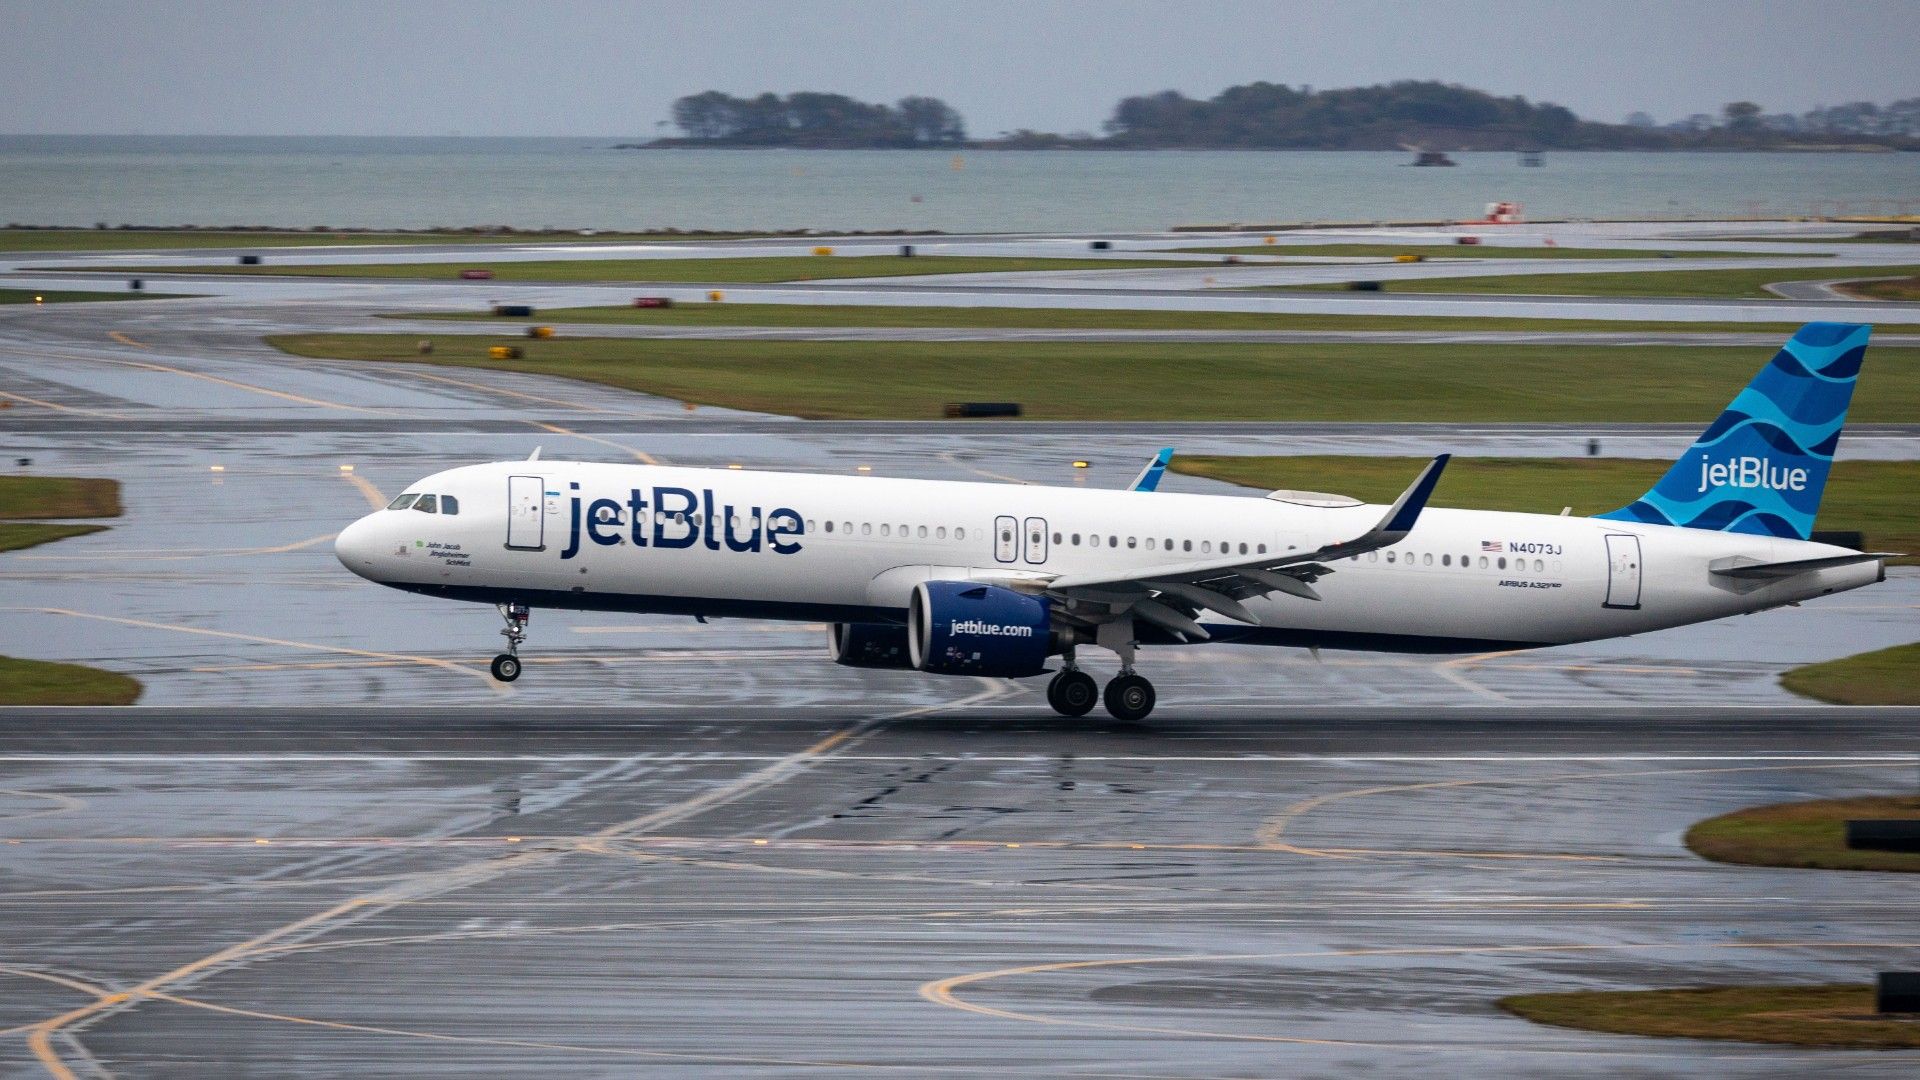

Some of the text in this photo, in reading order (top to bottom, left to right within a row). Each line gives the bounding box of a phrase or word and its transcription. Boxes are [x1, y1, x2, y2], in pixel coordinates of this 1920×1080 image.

[1698, 454, 1807, 492] jetBlue
[560, 482, 805, 559] jetBlue
[1510, 542, 1562, 555] N4073J
[1499, 580, 1528, 588] AIRBUS
[950, 619, 1032, 637] jetblue.com
